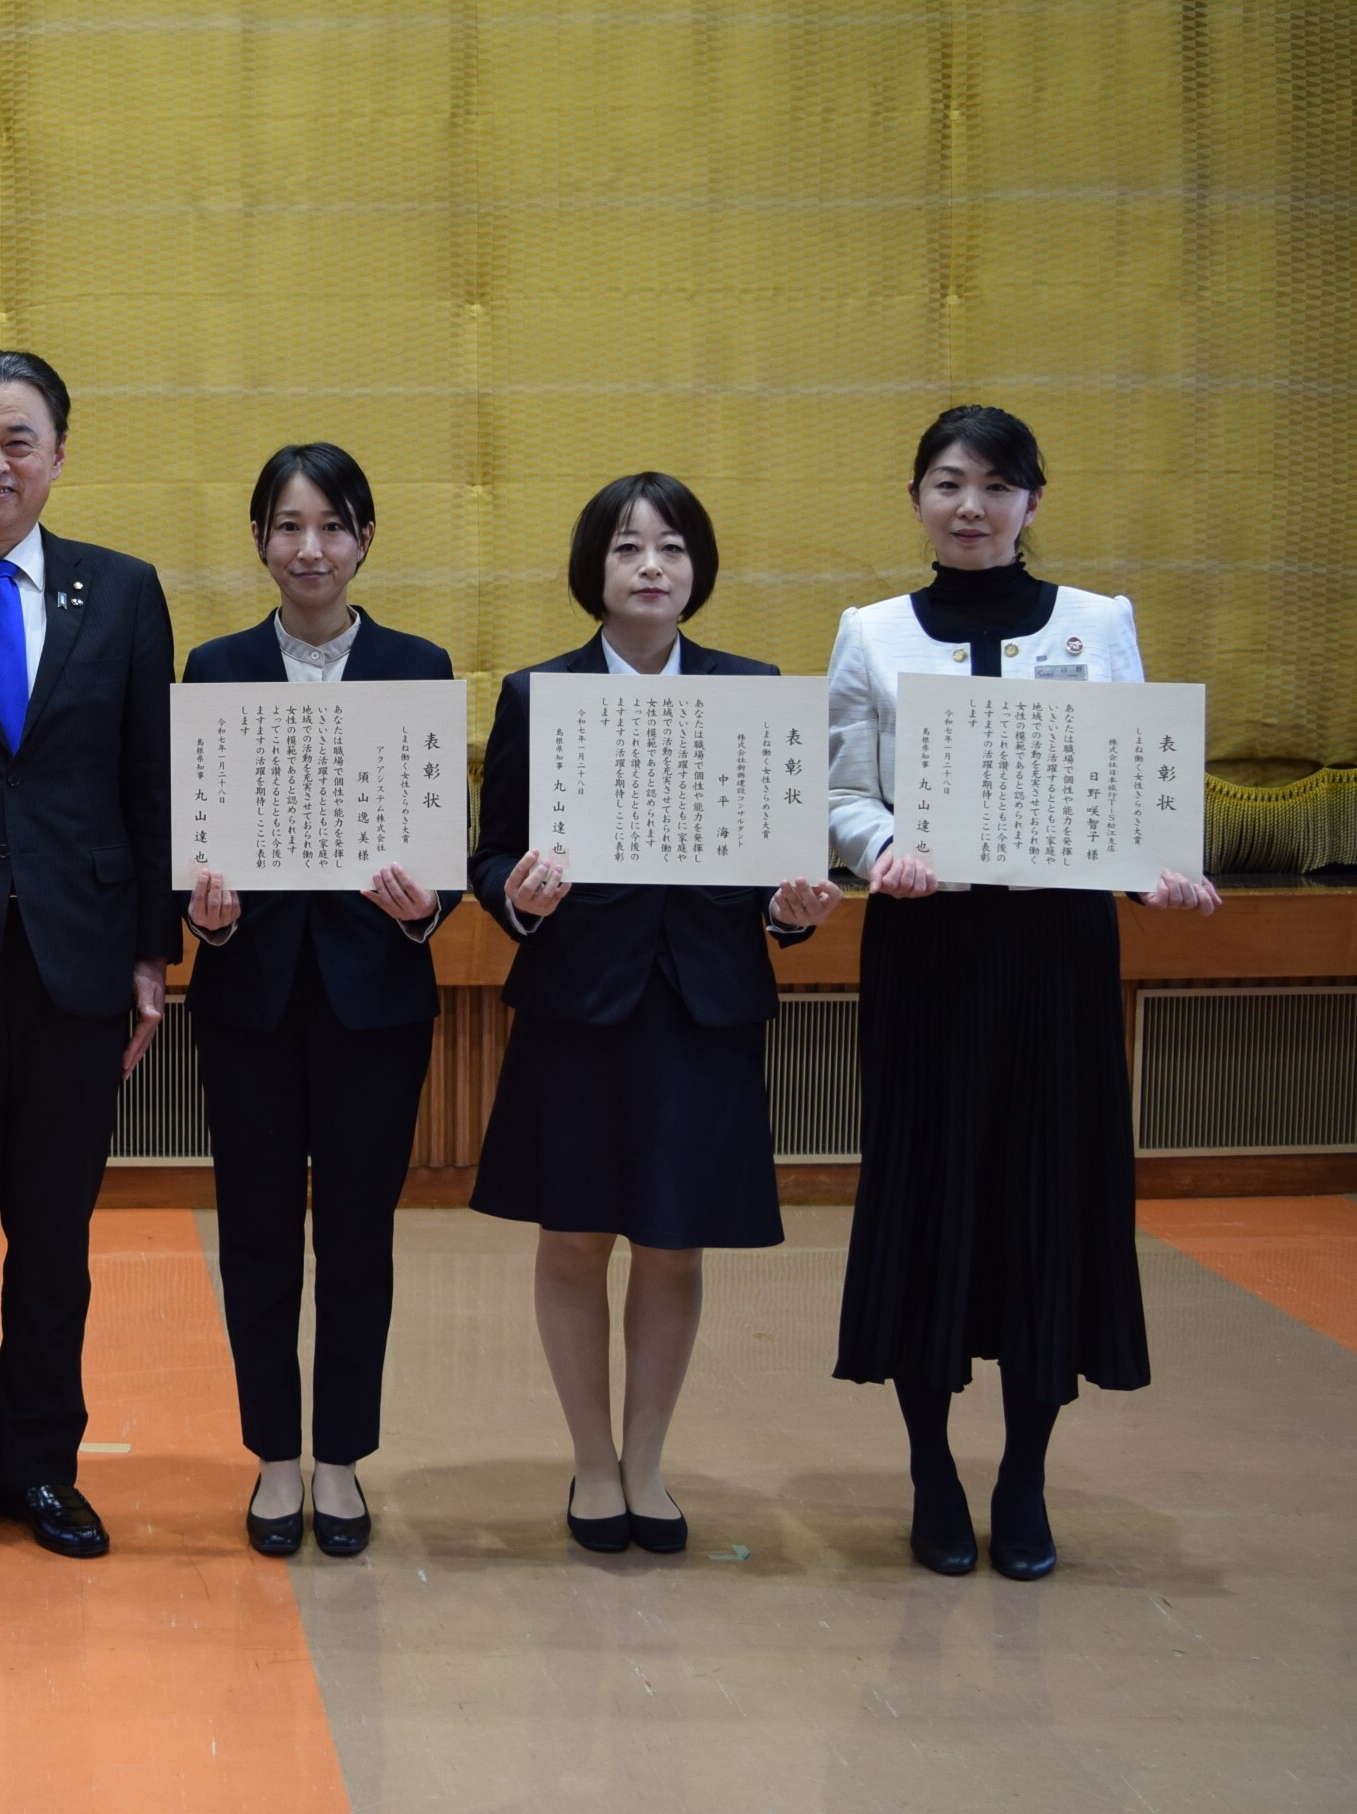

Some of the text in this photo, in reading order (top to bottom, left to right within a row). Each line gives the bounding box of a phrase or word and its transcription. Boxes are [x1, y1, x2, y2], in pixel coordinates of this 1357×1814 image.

[217, 718, 227, 804] 令和七年一月二十八日
[239, 706, 250, 735] します
[423, 732, 442, 809] 表彰状
[576, 709, 587, 795] 令和七年一月二十八日
[599, 698, 611, 726] します
[783, 728, 804, 805] 表彰状
[942, 709, 954, 795] 令和七年一月二十八日
[967, 699, 978, 728] します
[194, 789, 208, 864] 丸山達也
[254, 705, 267, 869] ますますの活躍を期待しここに表彰
[286, 705, 298, 855] 女性の模範であると認められます
[302, 705, 314, 869] 地域での活動を充実させておられ働く
[317, 706, 329, 868] いきいきと活躍するとともに家庭や
[332, 705, 344, 868] あなたは職場で個性や能力を発揮し
[375, 746, 386, 852] アクアシステム株式会社
[400, 726, 411, 844] しまね働く女性きらめき大賞
[552, 780, 567, 855] 丸山達也
[613, 697, 626, 862] ますますの活躍を期待しここに表彰
[645, 698, 657, 848] 女性の模範であると認められます
[660, 698, 674, 863] 地域での活動を充実させておられ働く
[676, 700, 689, 862] いきいきと活躍するとともに家庭や
[692, 699, 705, 863] あなたは職場で個性や能力を発揮し
[716, 774, 730, 856] 中平海様
[761, 721, 772, 839] しまね働く女性きらめき大賞
[915, 778, 932, 853] 丸山達也
[979, 700, 995, 863] ますますの活躍を期待しここに表彰
[1012, 702, 1027, 850] 女性の模範であると認められます
[1028, 702, 1043, 865] 地域での活動を充実させておられ働く
[1044, 704, 1059, 864] いきいきと活躍するとともに家庭や
[1061, 704, 1075, 866] あなたは職場で個性や能力を発揮し
[1132, 728, 1144, 845] しまね働く女性きらめき大賞
[1156, 735, 1178, 811] 表彰状
